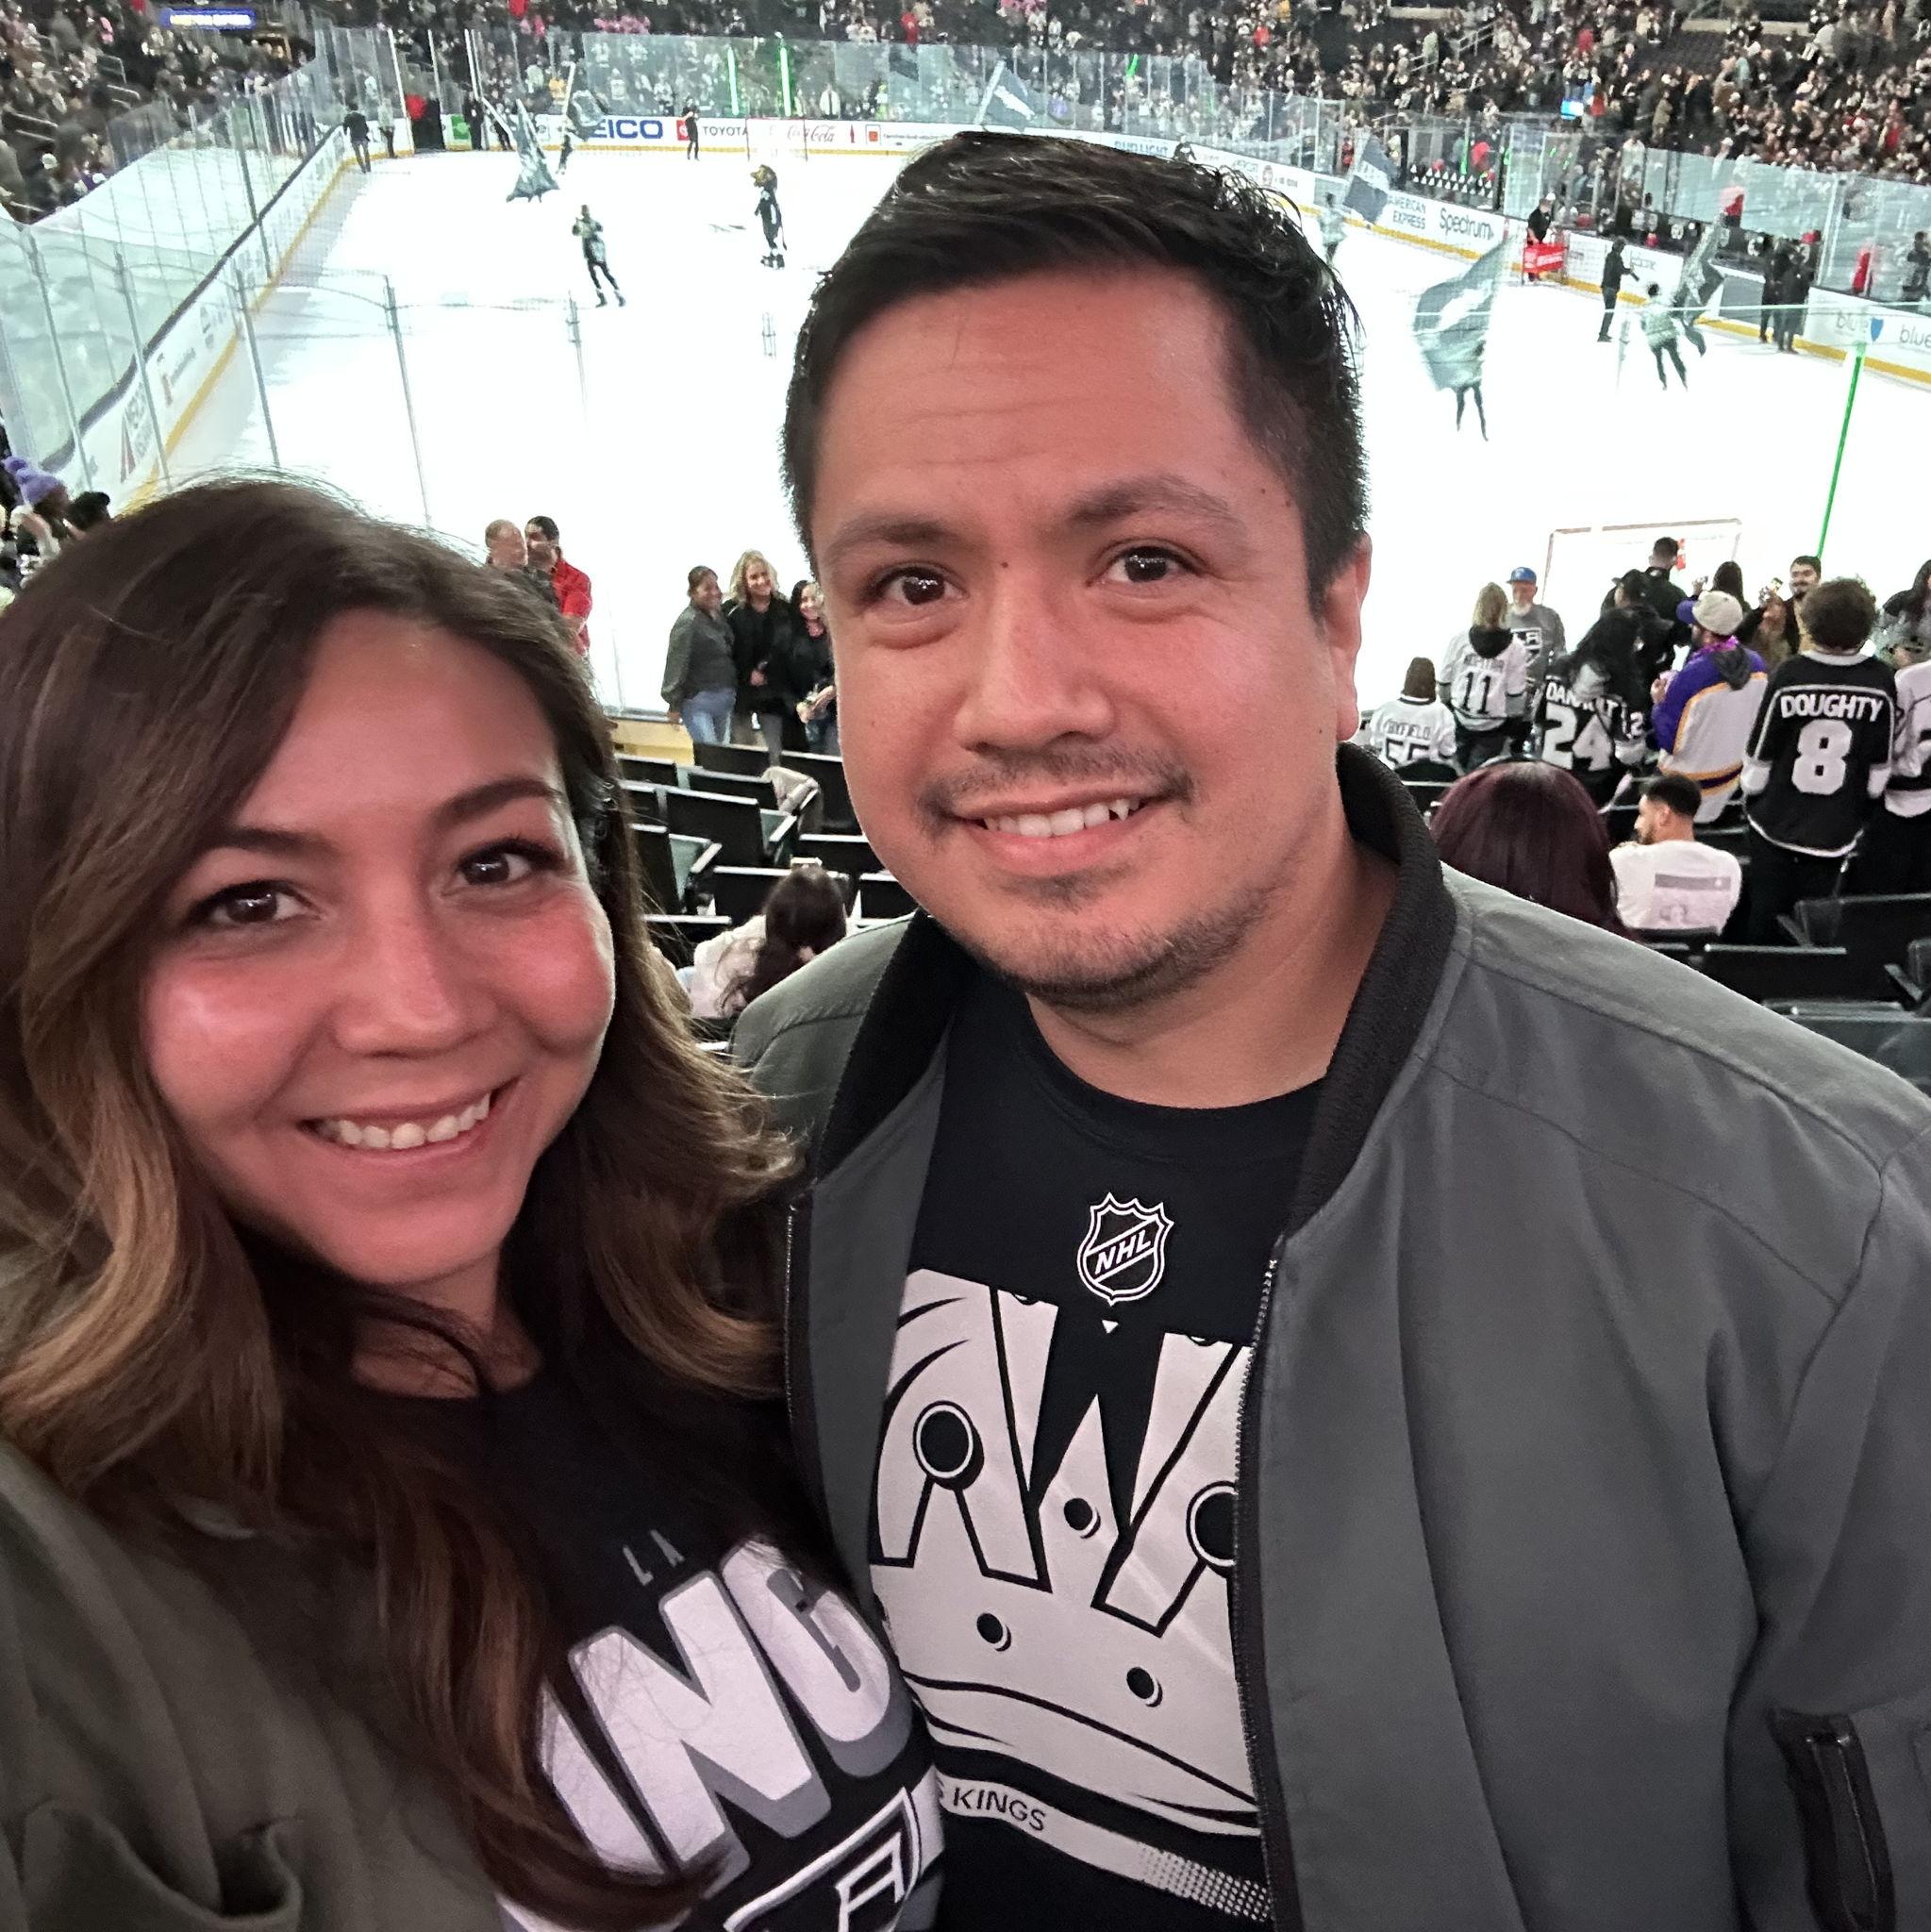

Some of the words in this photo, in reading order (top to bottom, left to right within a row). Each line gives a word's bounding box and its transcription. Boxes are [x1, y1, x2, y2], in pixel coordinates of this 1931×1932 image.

[589, 119, 663, 140] EICO
[703, 125, 748, 137] TOYOTA
[1440, 207, 1492, 240] Spectrum
[1460, 671, 1491, 715] 11
[1546, 681, 1619, 714] DANT
[1780, 693, 1884, 723] DOUGHTY
[1541, 701, 1612, 771] 24
[1791, 719, 1853, 795] 8
[1095, 1229, 1152, 1274] NHL
[623, 1528, 685, 1586] LA
[954, 1787, 1046, 1831] KINGS
